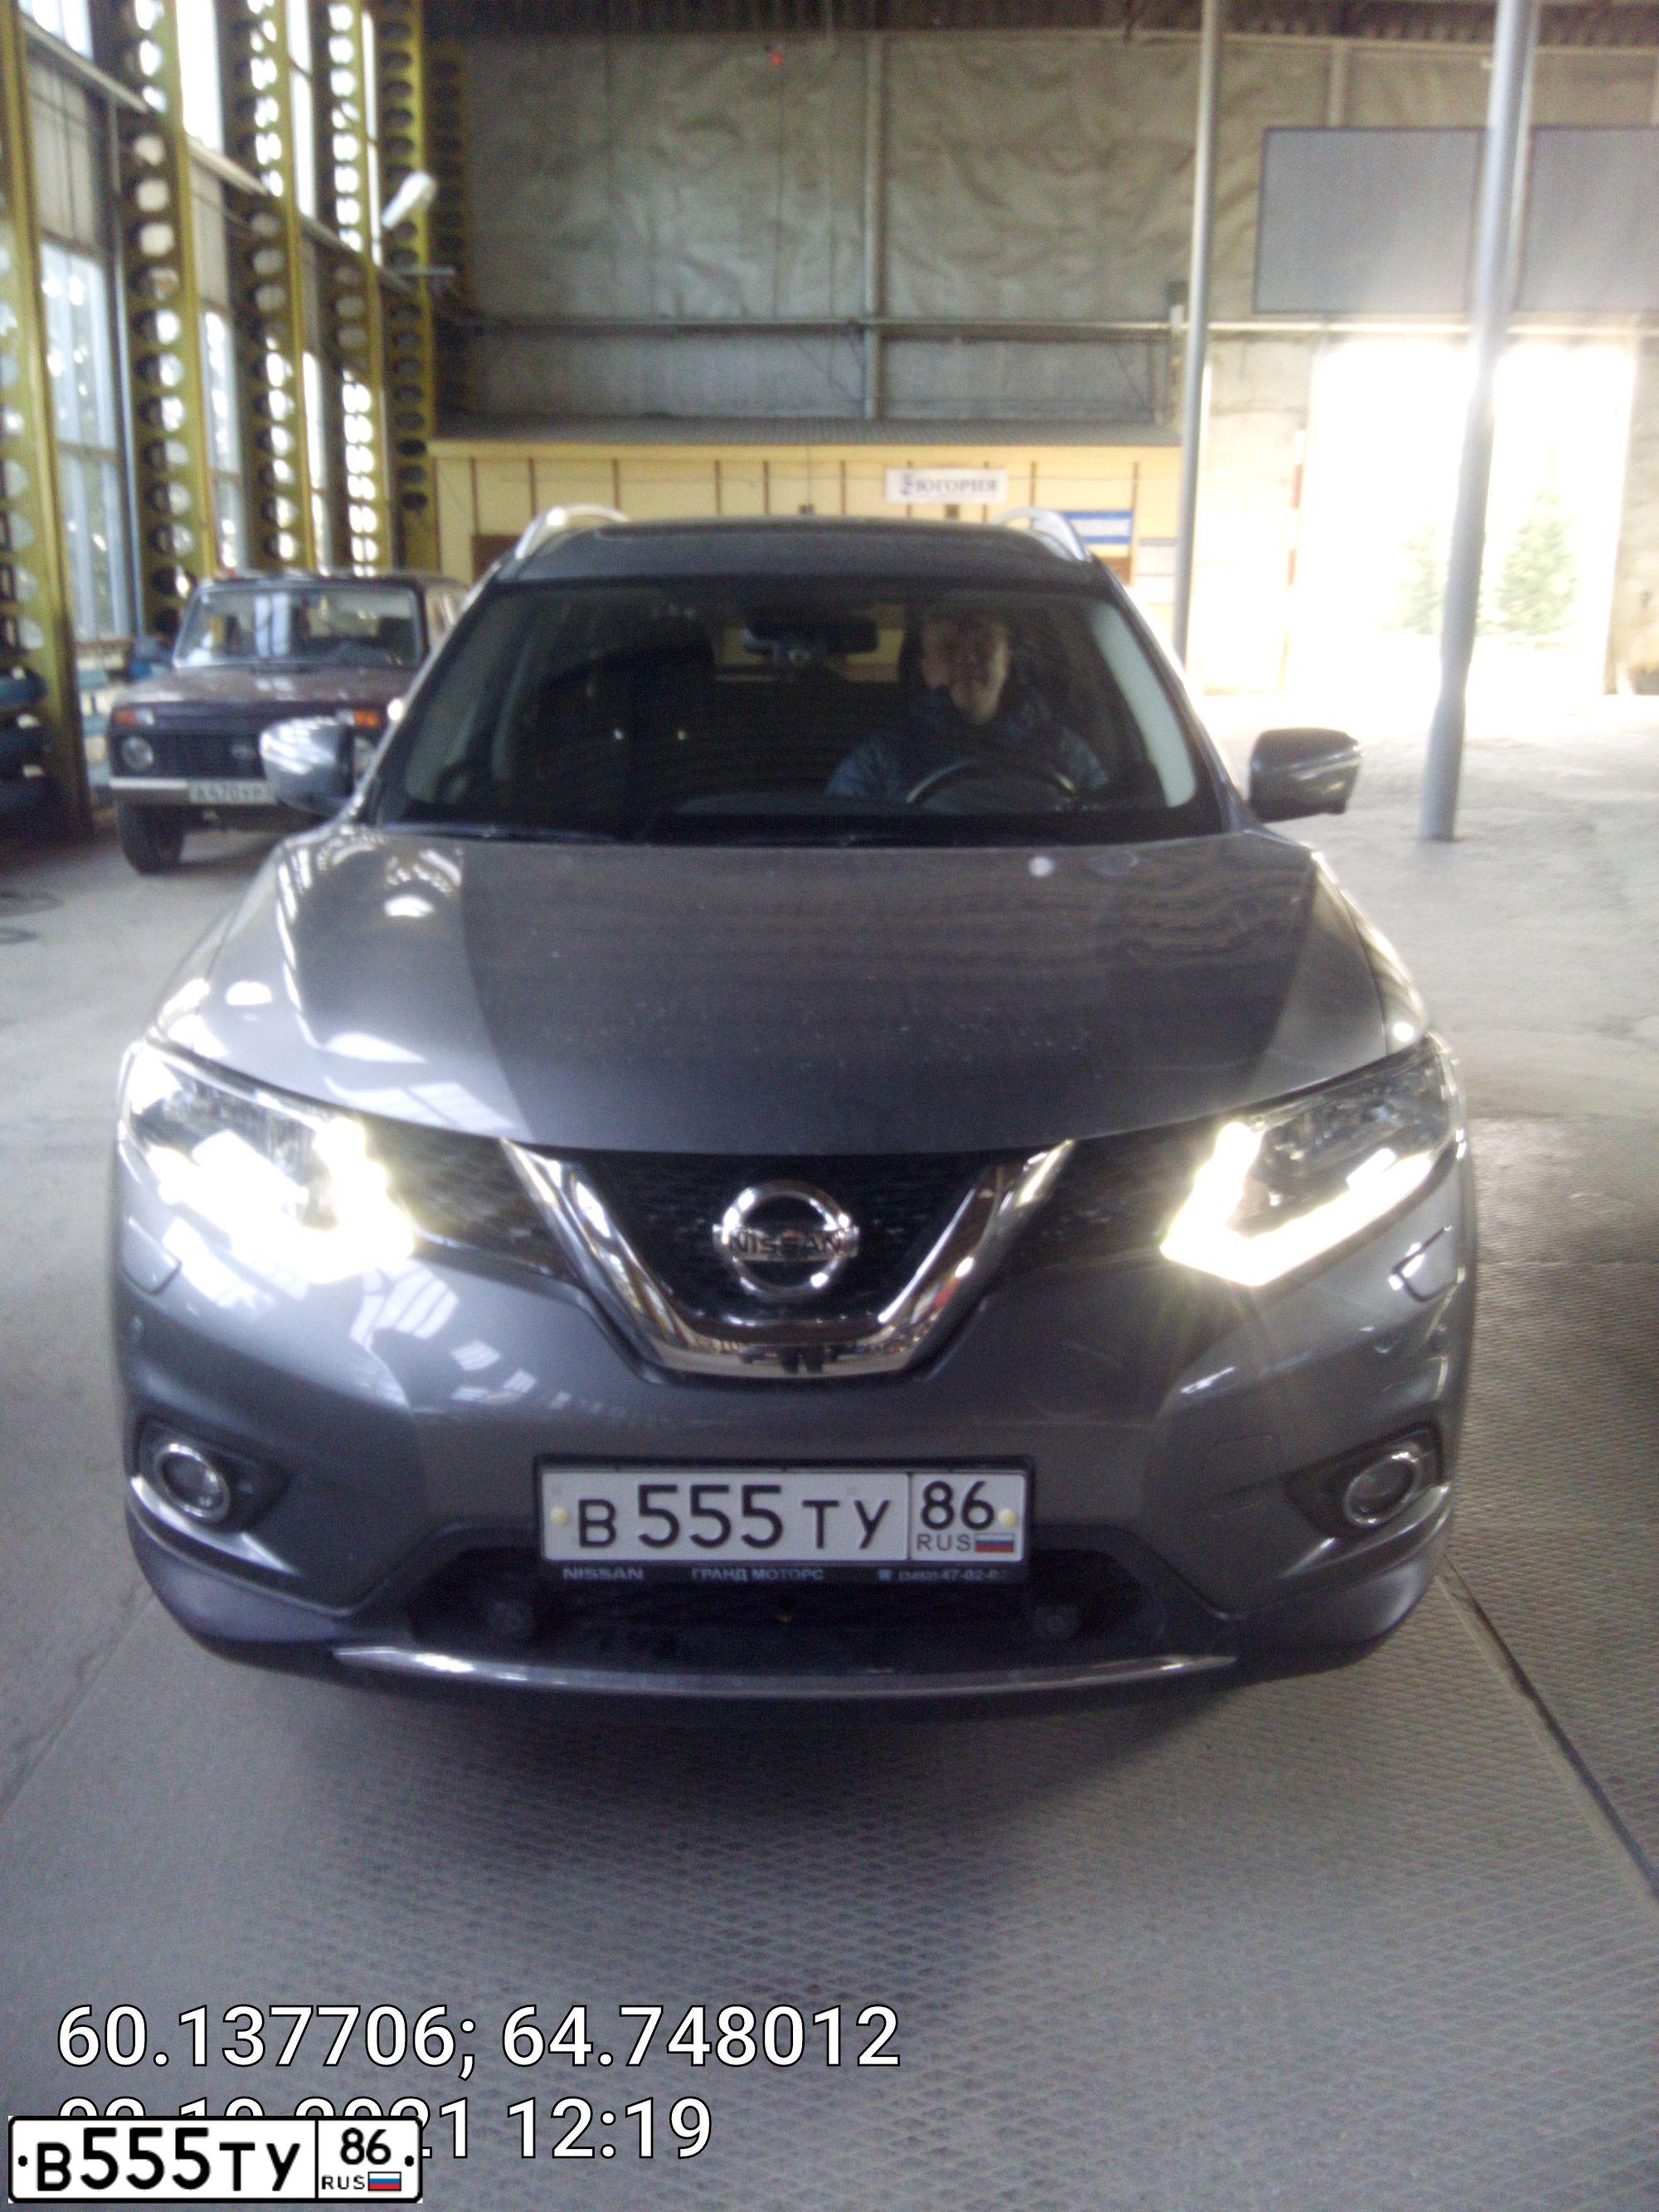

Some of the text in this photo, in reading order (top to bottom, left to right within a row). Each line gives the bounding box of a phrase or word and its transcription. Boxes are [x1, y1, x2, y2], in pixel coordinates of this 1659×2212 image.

[921, 1480, 995, 1532] 86
[917, 1534, 971, 1552] RUS
[562, 1566, 645, 1581] NISSAN
[691, 1567, 825, 1583] ГРАНД МОТОРС
